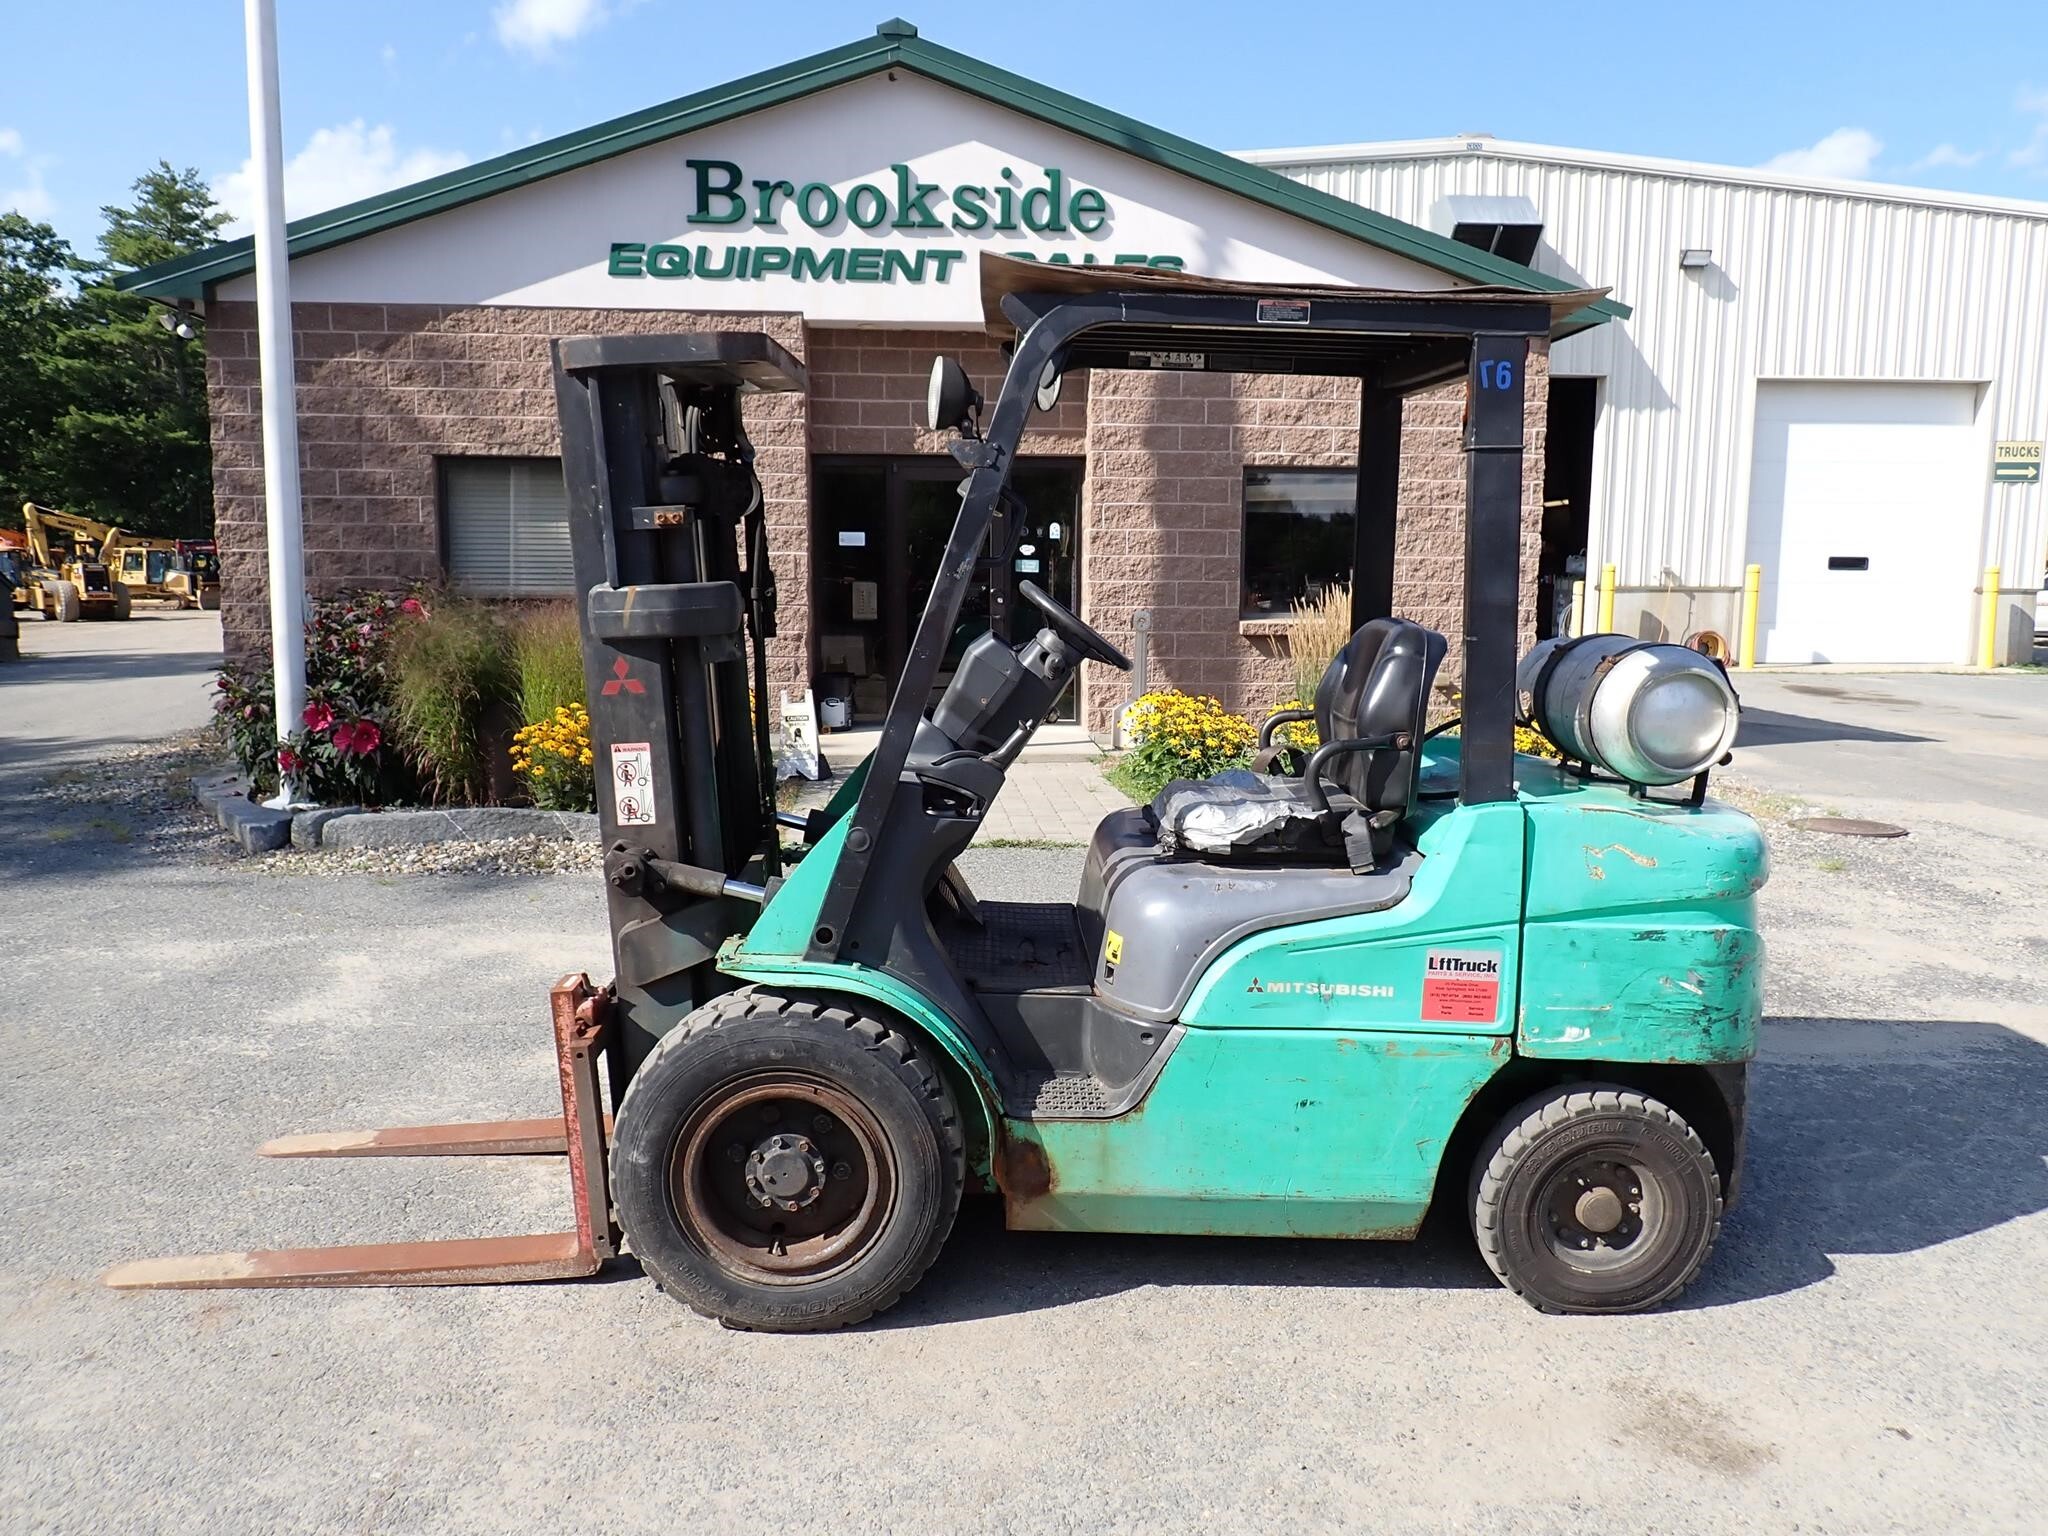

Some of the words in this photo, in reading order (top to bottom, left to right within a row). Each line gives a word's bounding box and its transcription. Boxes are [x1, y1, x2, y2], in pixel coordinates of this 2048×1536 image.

[686, 159, 1106, 232] Brookside
[607, 243, 963, 282] EQUIPMENT
[1998, 446, 2040, 458] TRUCKS
[1267, 982, 1394, 997] MITSUBISHI
